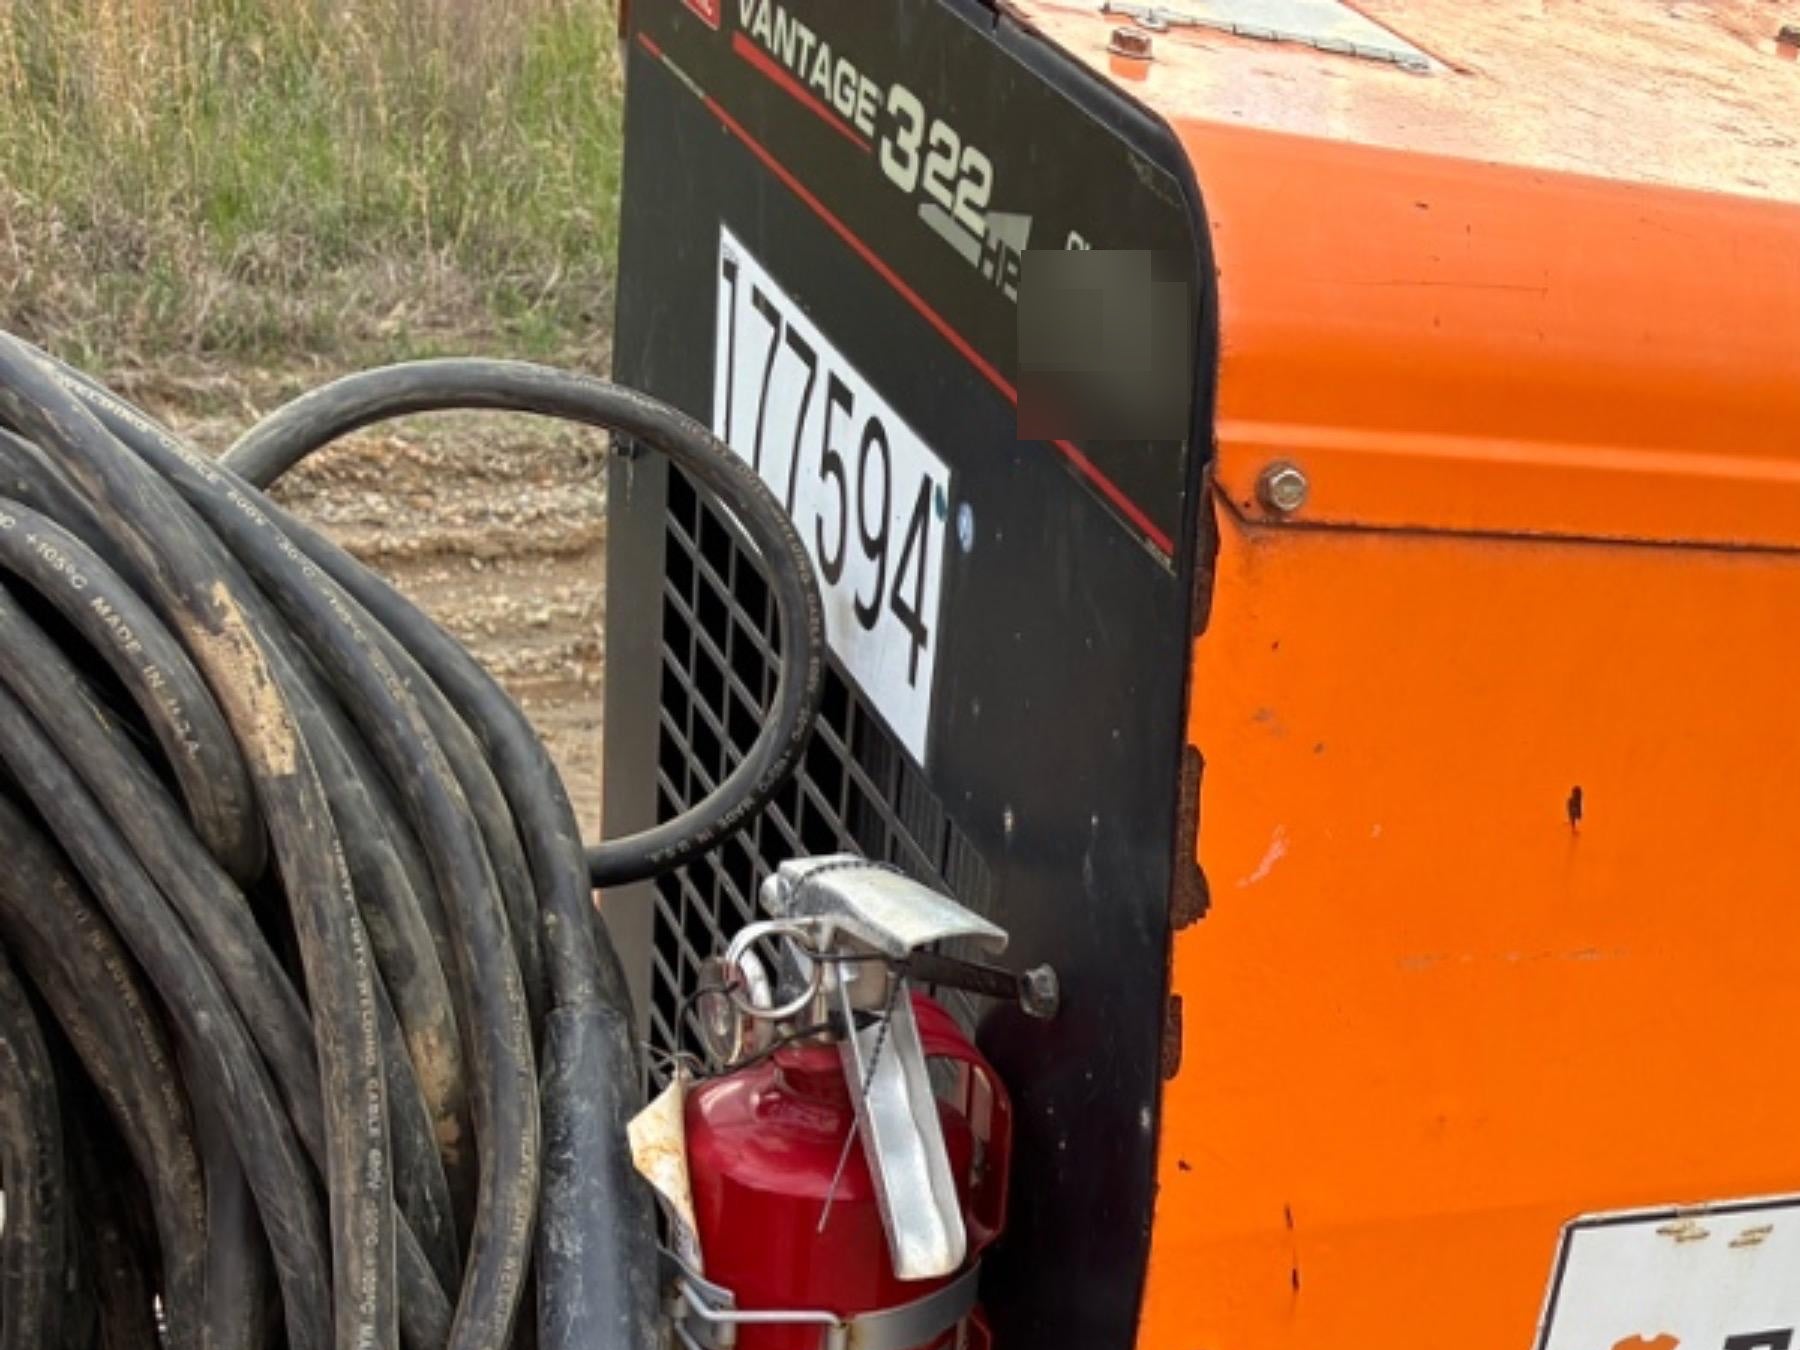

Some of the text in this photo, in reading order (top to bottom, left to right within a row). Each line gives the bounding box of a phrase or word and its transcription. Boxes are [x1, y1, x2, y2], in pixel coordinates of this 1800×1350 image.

[880, 84, 993, 238] 322
[720, 257, 932, 690] 177594
[90, 596, 142, 654] MADE
